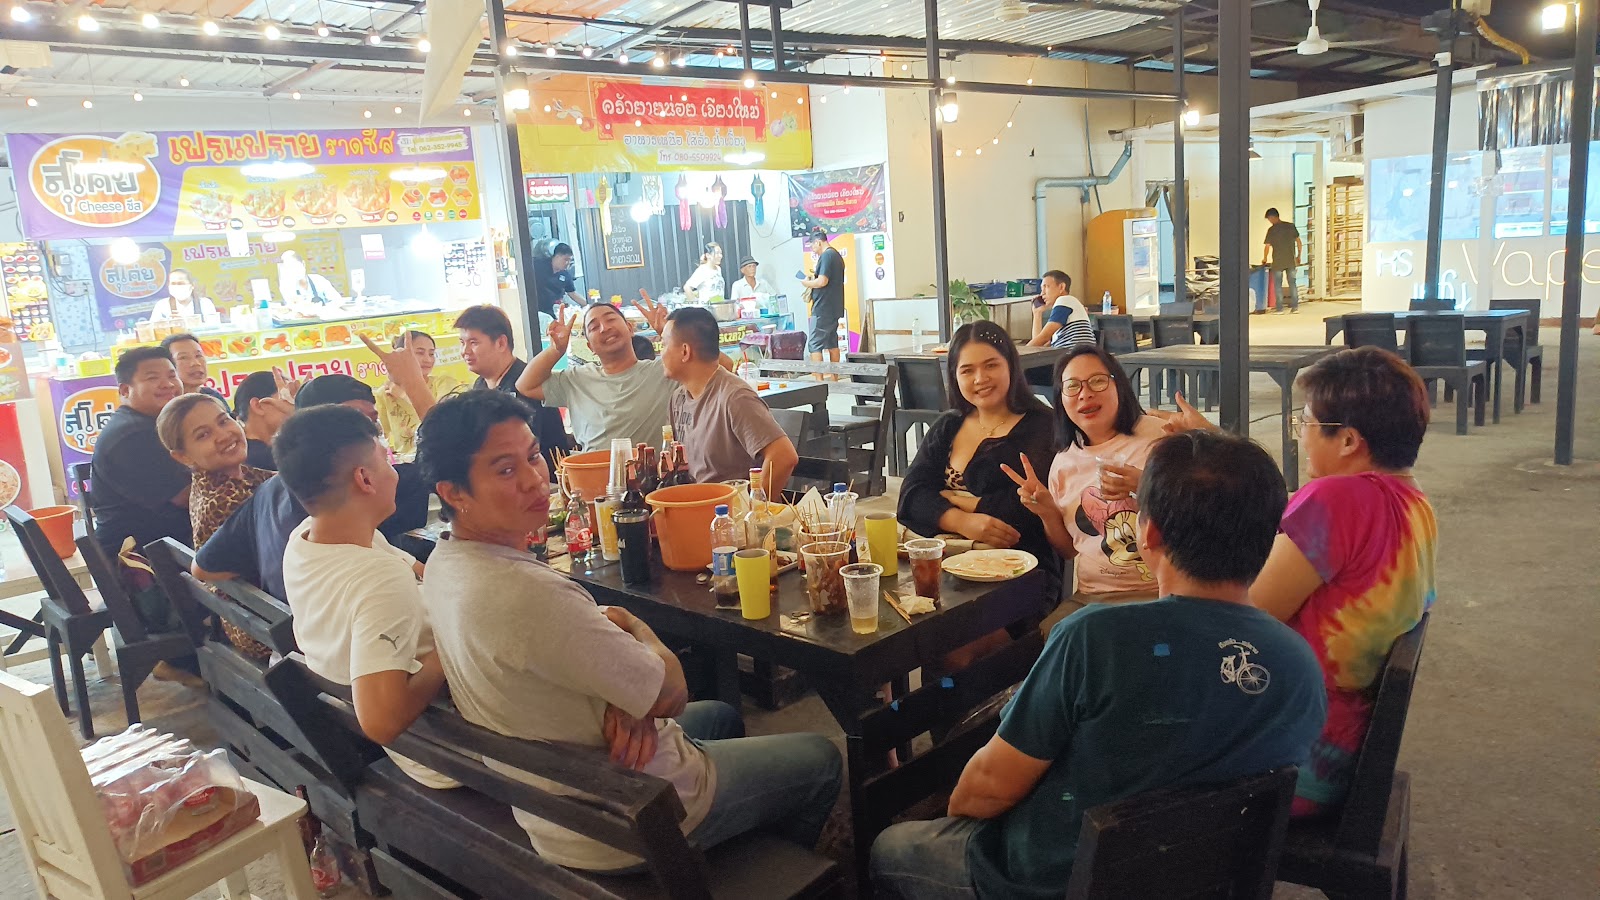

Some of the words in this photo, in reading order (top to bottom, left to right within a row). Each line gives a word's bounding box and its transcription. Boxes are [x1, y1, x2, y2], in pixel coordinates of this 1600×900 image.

[169, 131, 321, 163] เฟรนฟราย
[326, 128, 395, 156] ราดชีส
[79, 200, 122, 212] Cheese
